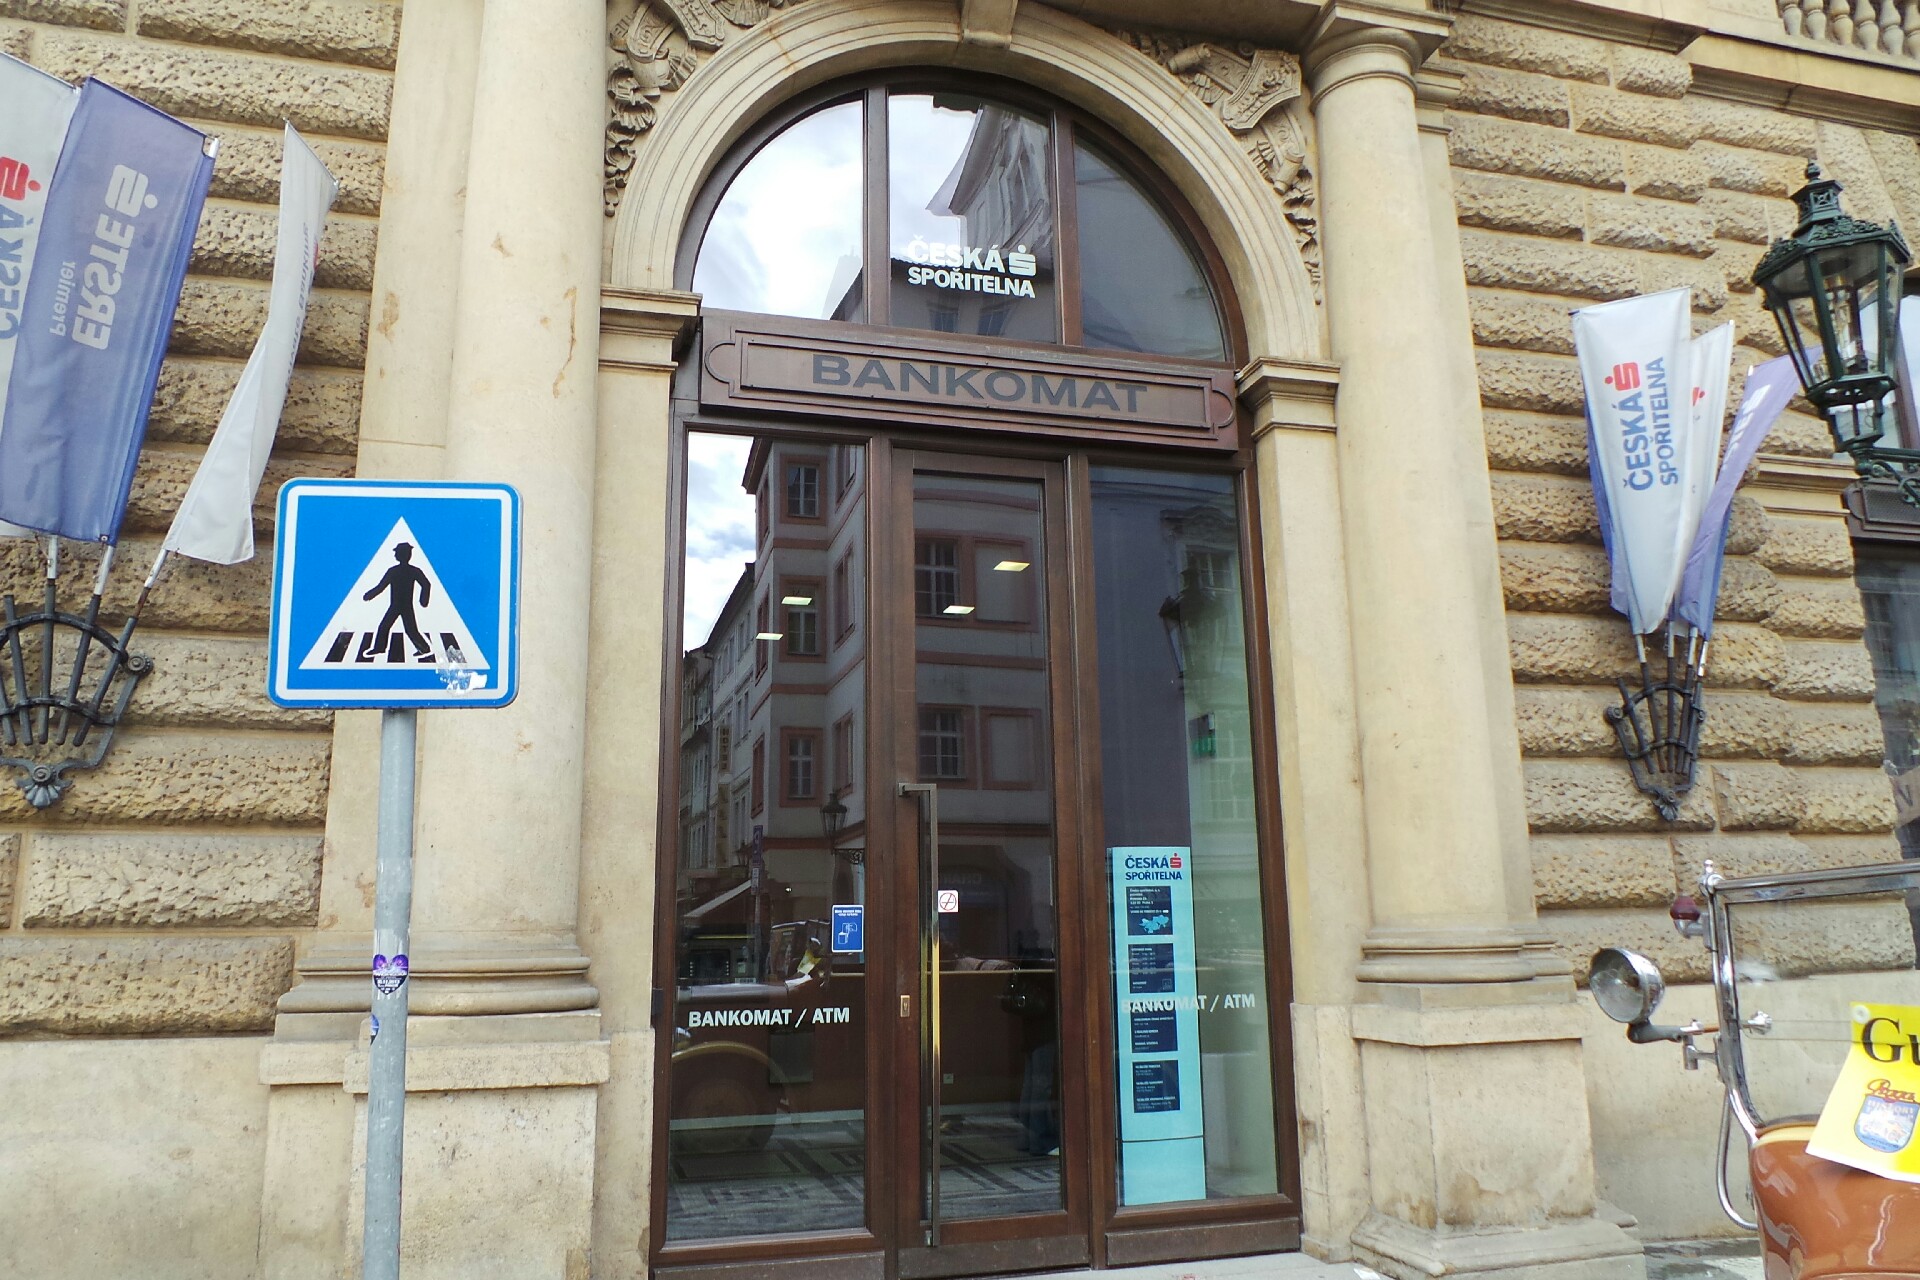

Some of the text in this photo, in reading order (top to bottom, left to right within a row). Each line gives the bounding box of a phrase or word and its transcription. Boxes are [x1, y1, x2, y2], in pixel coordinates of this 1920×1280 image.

[907, 234, 1006, 274] ČESKÁ
[907, 266, 1036, 299] SPOŘITELNA
[812, 353, 1148, 413] BANKOMAT
[1645, 356, 1679, 486] SPOŘITELNA
[1612, 391, 1654, 491] ČESKÁ
[1124, 855, 1169, 869] ČESKÁ
[1125, 870, 1183, 881] SPOŘITELNA
[688, 1007, 850, 1028] BANKOMAT / ATM
[1121, 995, 1207, 1013] BANKOMAT
[1223, 993, 1255, 1009] ATM
